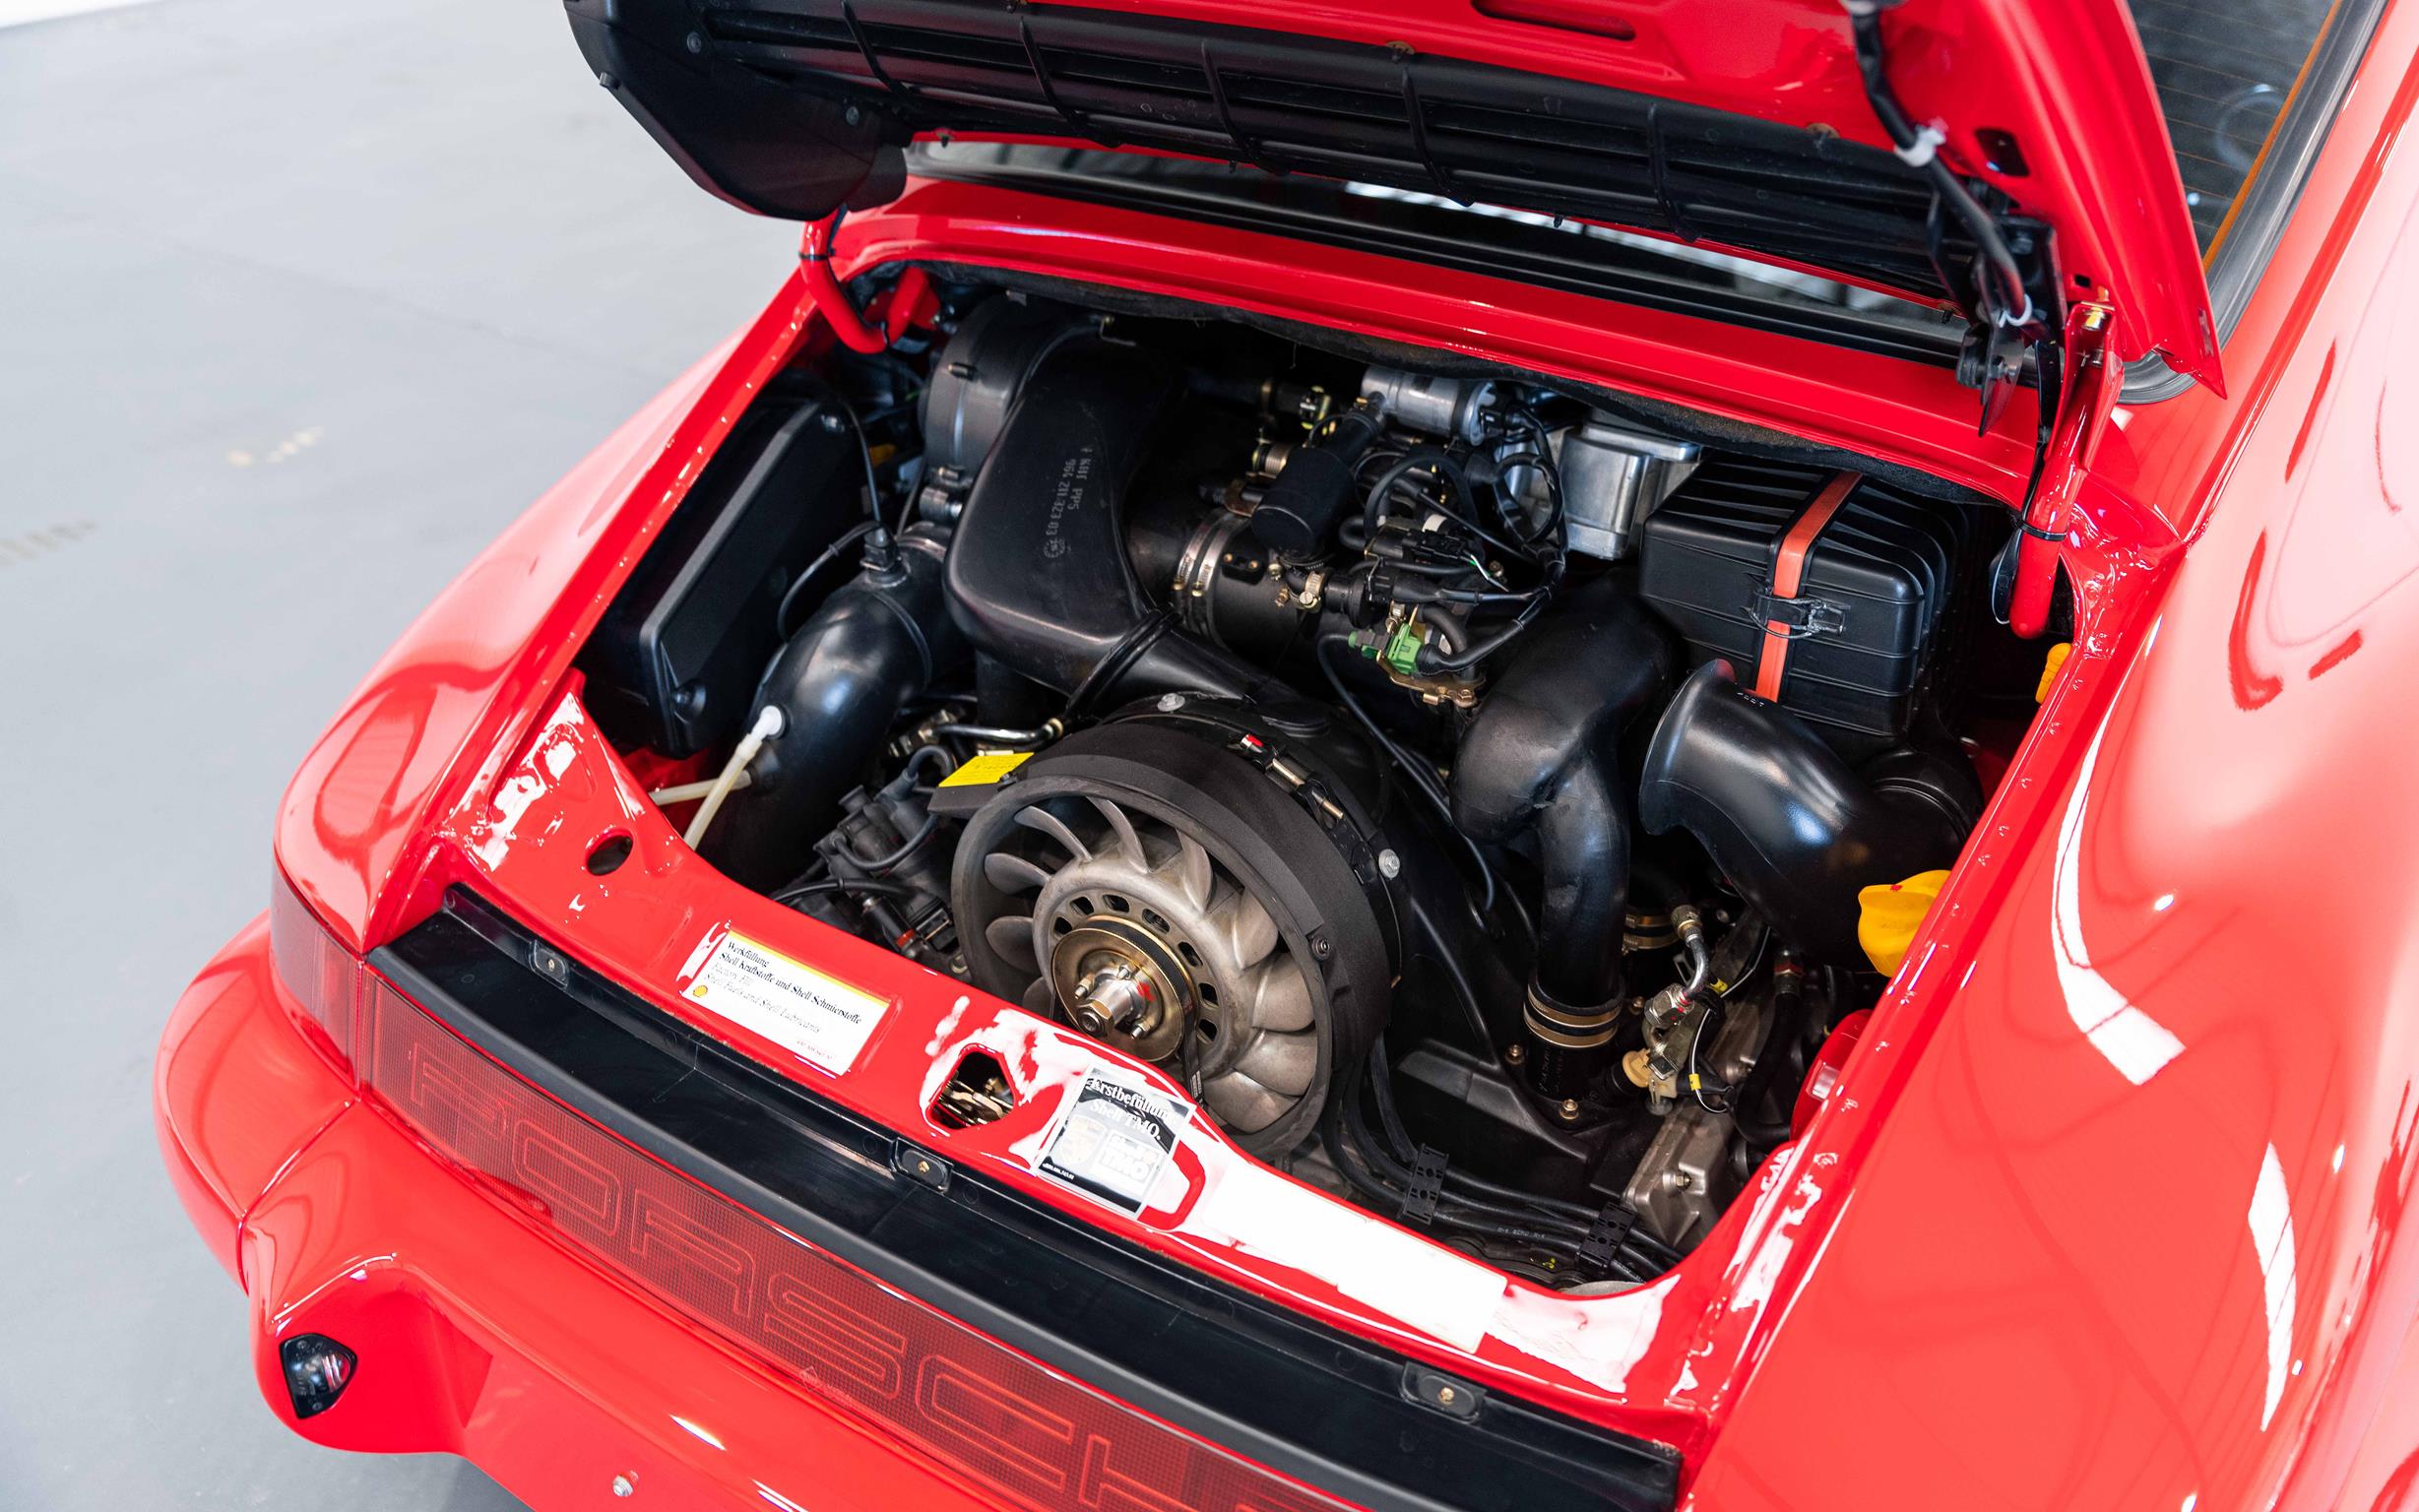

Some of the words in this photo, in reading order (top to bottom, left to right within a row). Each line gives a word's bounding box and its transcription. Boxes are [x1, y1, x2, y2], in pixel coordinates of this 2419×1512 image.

[729, 941, 770, 969] Werkfüllung
[719, 952, 740, 966] Shell
[775, 978, 793, 991] und
[791, 984, 813, 1001] Shell
[810, 995, 862, 1025] Schmierstoffe
[1089, 1101, 1124, 1121] Shell
[1090, 1077, 1176, 1123] Erstbefüllun
